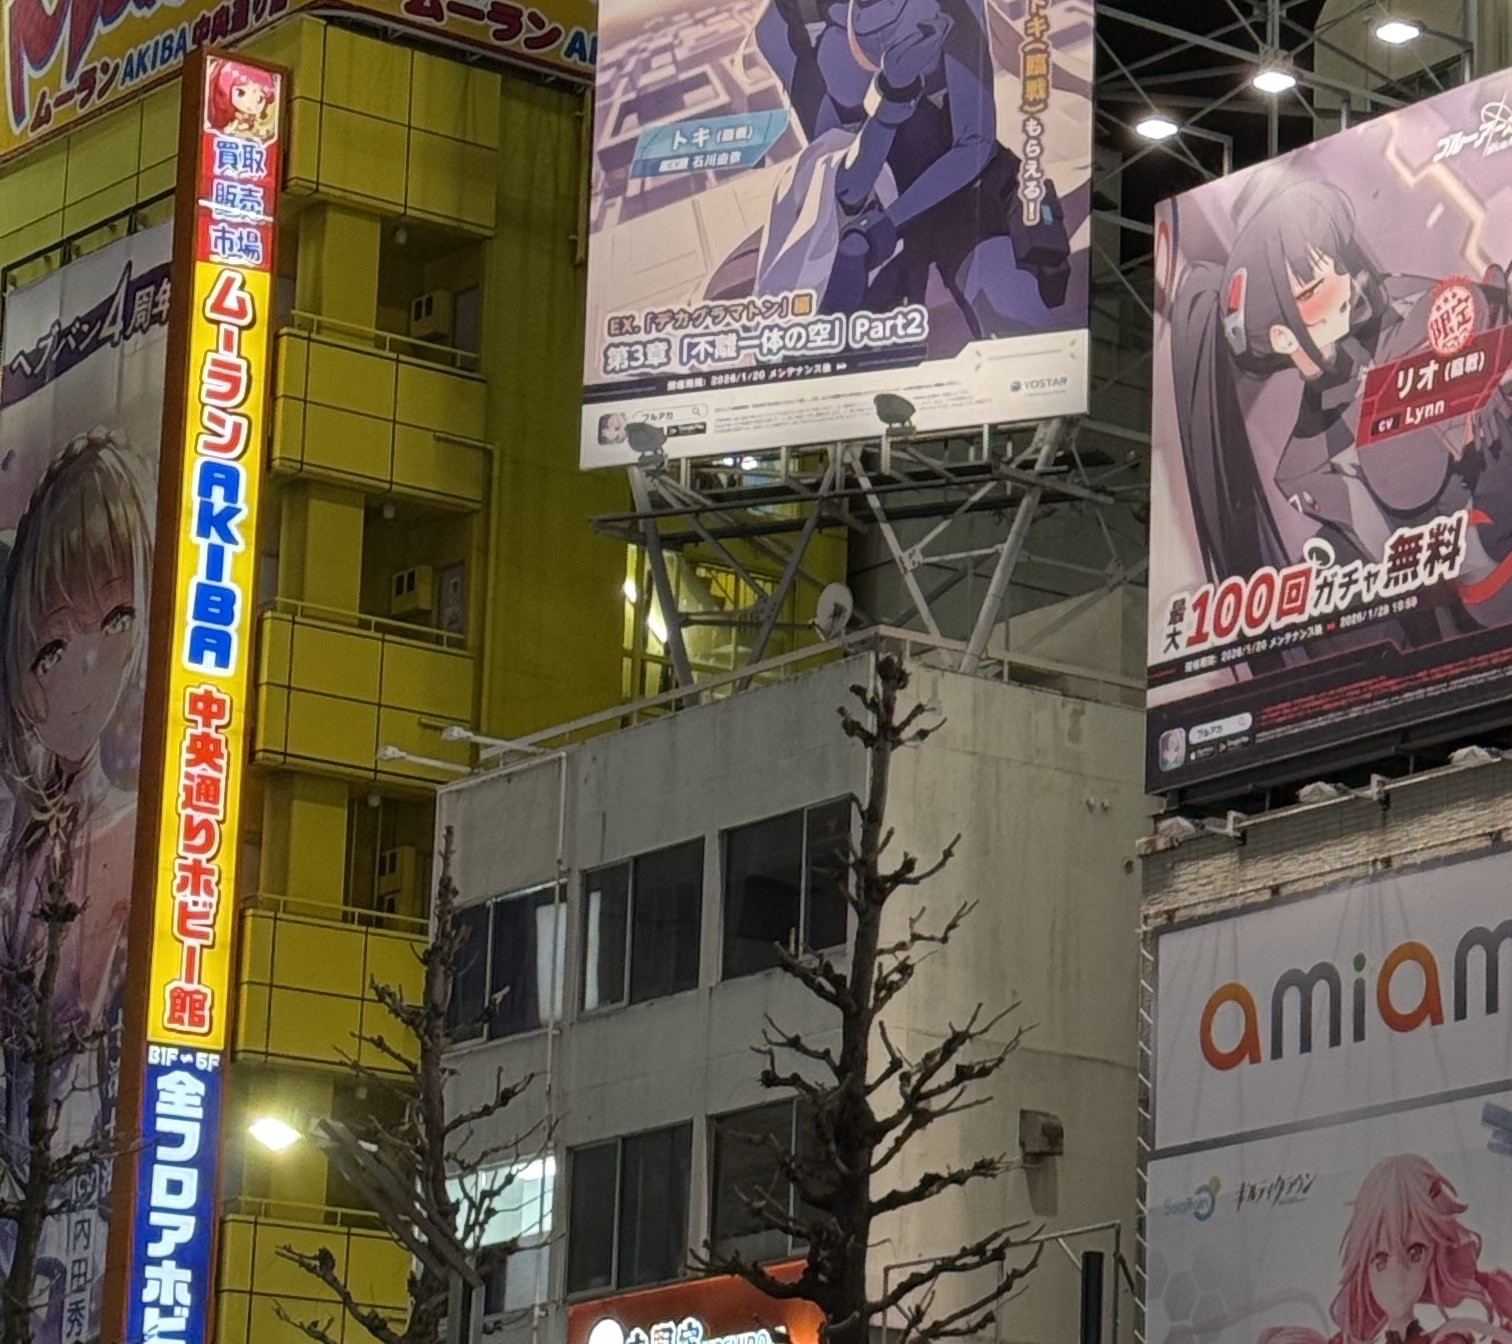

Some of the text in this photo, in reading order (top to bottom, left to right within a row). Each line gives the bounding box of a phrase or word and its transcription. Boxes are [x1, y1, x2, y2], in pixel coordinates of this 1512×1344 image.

[215, 140, 266, 174] 買取
[672, 129, 710, 151] トキ
[211, 226, 263, 262] 市場
[606, 341, 669, 372] 第3章
[854, 312, 924, 341] Part2
[1397, 360, 1439, 399] リオ
[1405, 400, 1445, 425] Lynn
[166, 688, 228, 1030] 中央通りホビー館
